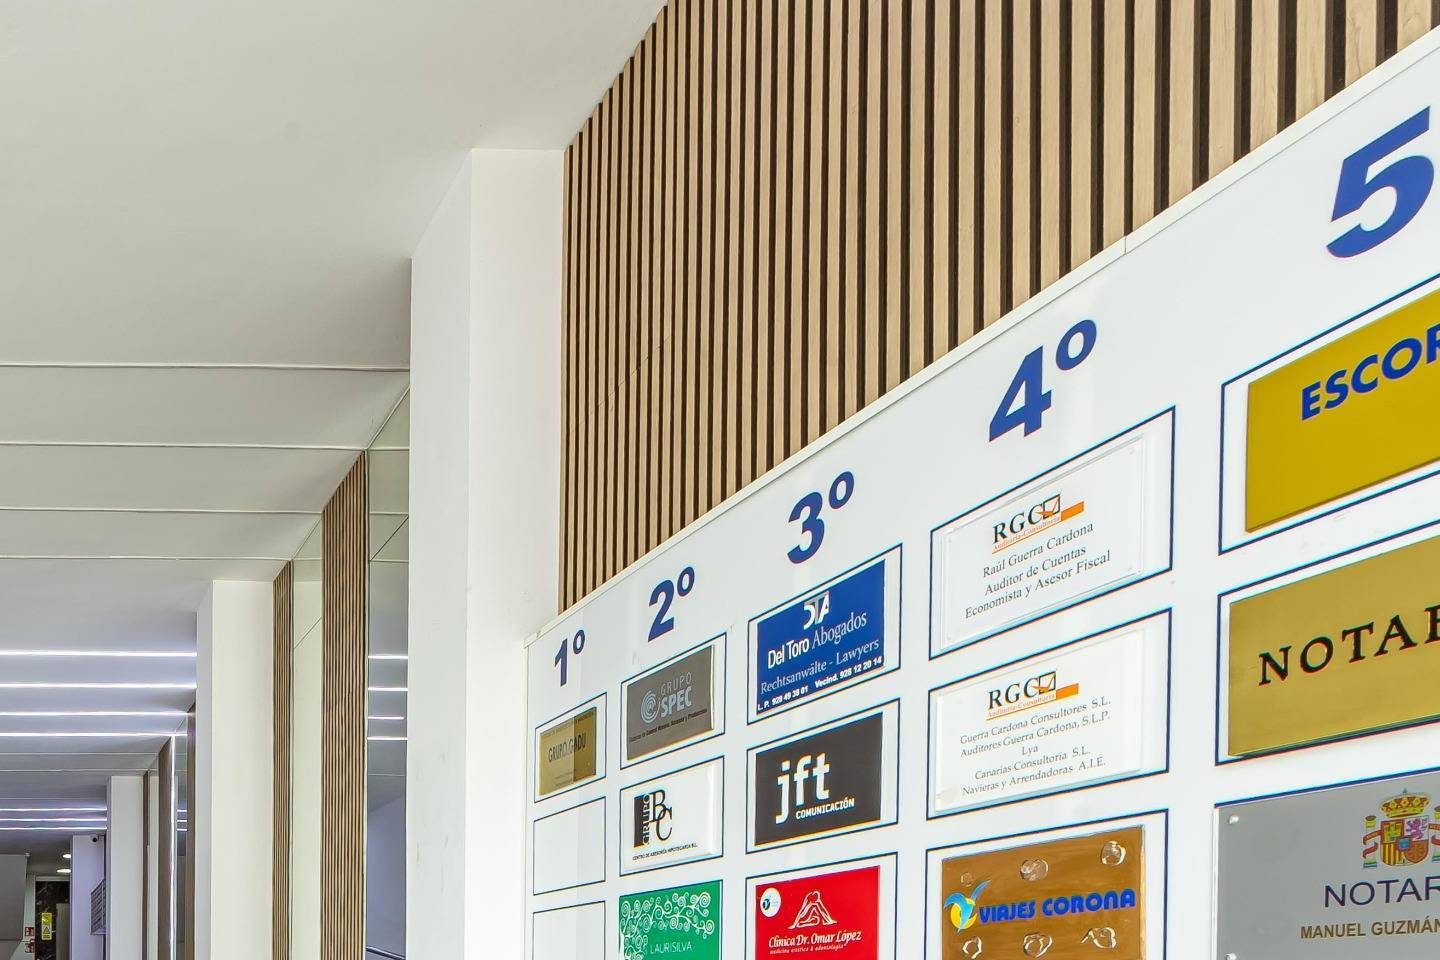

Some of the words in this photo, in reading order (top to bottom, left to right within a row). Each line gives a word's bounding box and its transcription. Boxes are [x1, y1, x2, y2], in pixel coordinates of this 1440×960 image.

[1326, 105, 1435, 258] 5
[989, 319, 1097, 442] 4º
[787, 471, 855, 564] 3º
[983, 558, 1006, 578] Raúl
[1008, 544, 1044, 567] Guerra
[1046, 523, 1094, 550] Cardona
[985, 572, 1024, 596] Auditor
[1026, 564, 1039, 578] de
[1042, 546, 1086, 571] Cuentas
[648, 566, 695, 642] 2º
[965, 588, 1022, 619] Economista
[1025, 585, 1032, 598] y
[1035, 567, 1073, 591] Asesor
[1076, 549, 1111, 574] Fiscal
[768, 644, 785, 669] Del
[786, 638, 810, 659] Toro
[812, 611, 867, 650] Abogados
[661, 671, 692, 695] GRUPO
[760, 659, 827, 695] Rechtsanwälte
[836, 638, 880, 665] Lawyers
[661, 685, 693, 718] SPEC
[960, 731, 989, 745] Guerra
[990, 720, 1028, 736] Cardona
[1030, 702, 1087, 725] Consultores
[1091, 695, 1111, 709] S.L.
[960, 741, 1002, 758] Auditores
[1002, 733, 1034, 747] Guerra
[1036, 719, 1080, 738] Cardona,
[1082, 710, 1111, 726] S.L.P.
[962, 781, 999, 796] Navieras
[1000, 780, 1007, 791] y
[1009, 763, 1073, 786] Arrendadoras
[1078, 756, 1106, 771] A.I.E.
[974, 763, 1012, 780] Canarias
[1072, 745, 1091, 757] S.L.
[775, 752, 830, 825] jft
[795, 796, 855, 820] COMUNICACIÓN
[978, 900, 1036, 924] VIAJES
[1041, 888, 1137, 917] CORONA
[1324, 875, 1440, 909] NOTAR
[650, 941, 692, 955] LAURISILVA
[796, 934, 810, 946] Dr.
[810, 932, 835, 945] Omar
[835, 929, 862, 946] López
[1300, 922, 1366, 940] MANUEL
